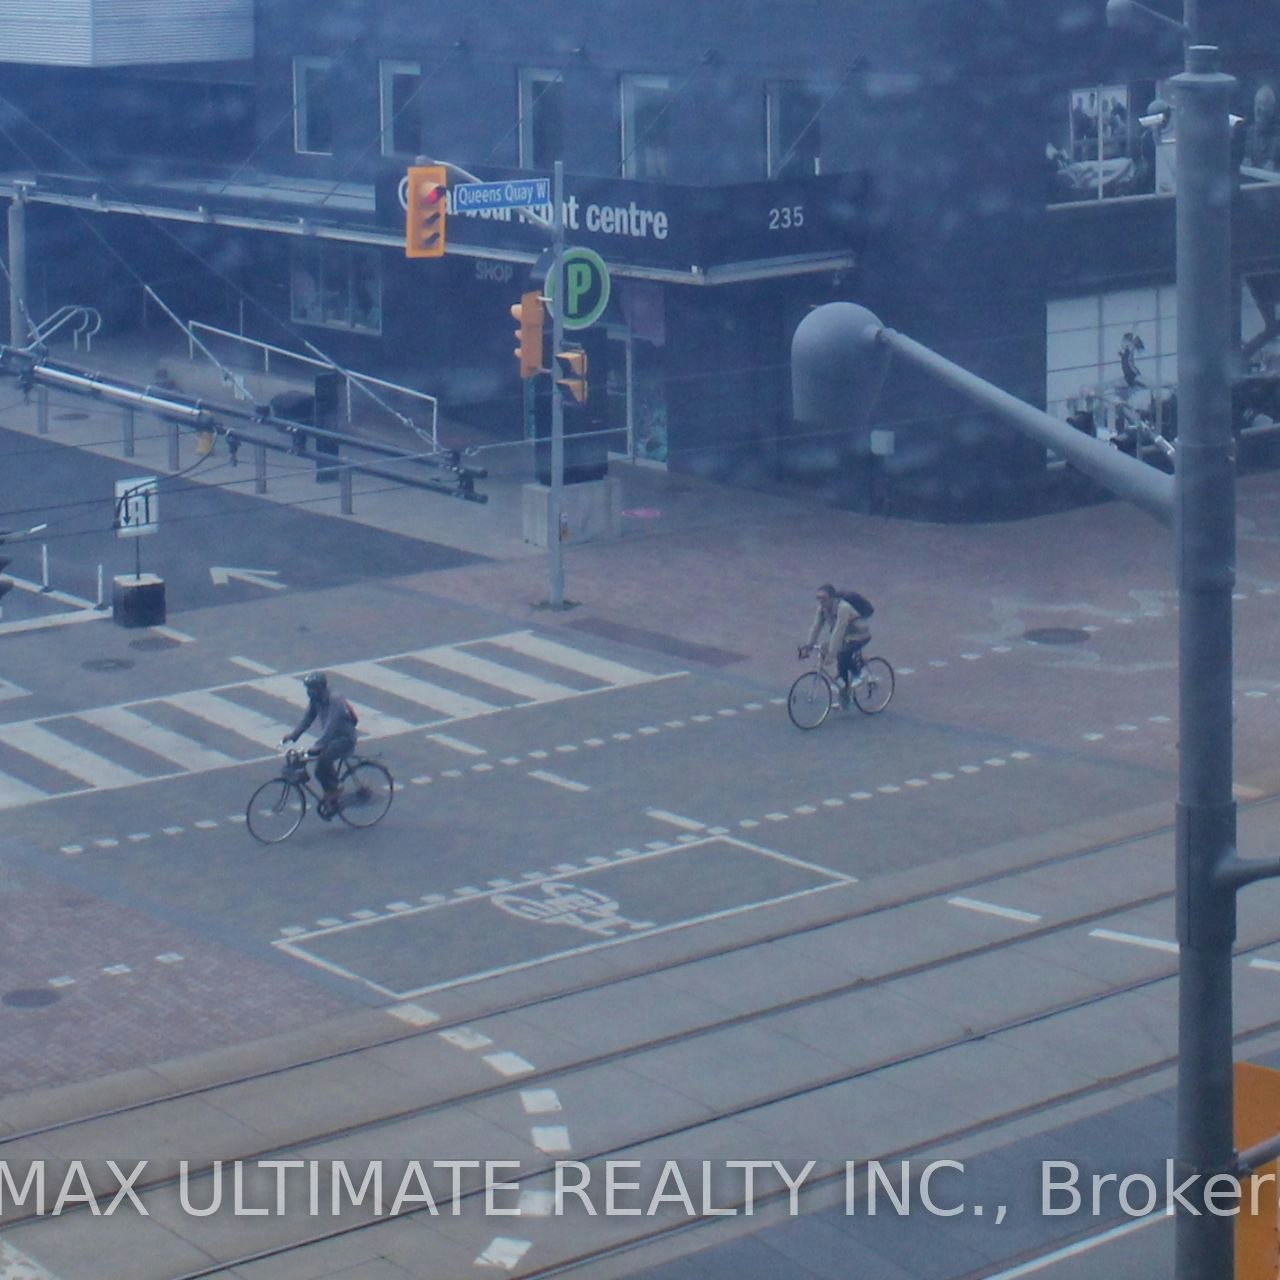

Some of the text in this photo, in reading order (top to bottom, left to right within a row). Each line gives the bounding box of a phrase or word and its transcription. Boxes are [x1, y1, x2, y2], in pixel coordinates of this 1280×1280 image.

[459, 181, 547, 205] Queens Quay W
[585, 202, 669, 240] centre
[769, 206, 804, 230] 235
[475, 261, 513, 284] SHOP
[567, 264, 592, 315] P
